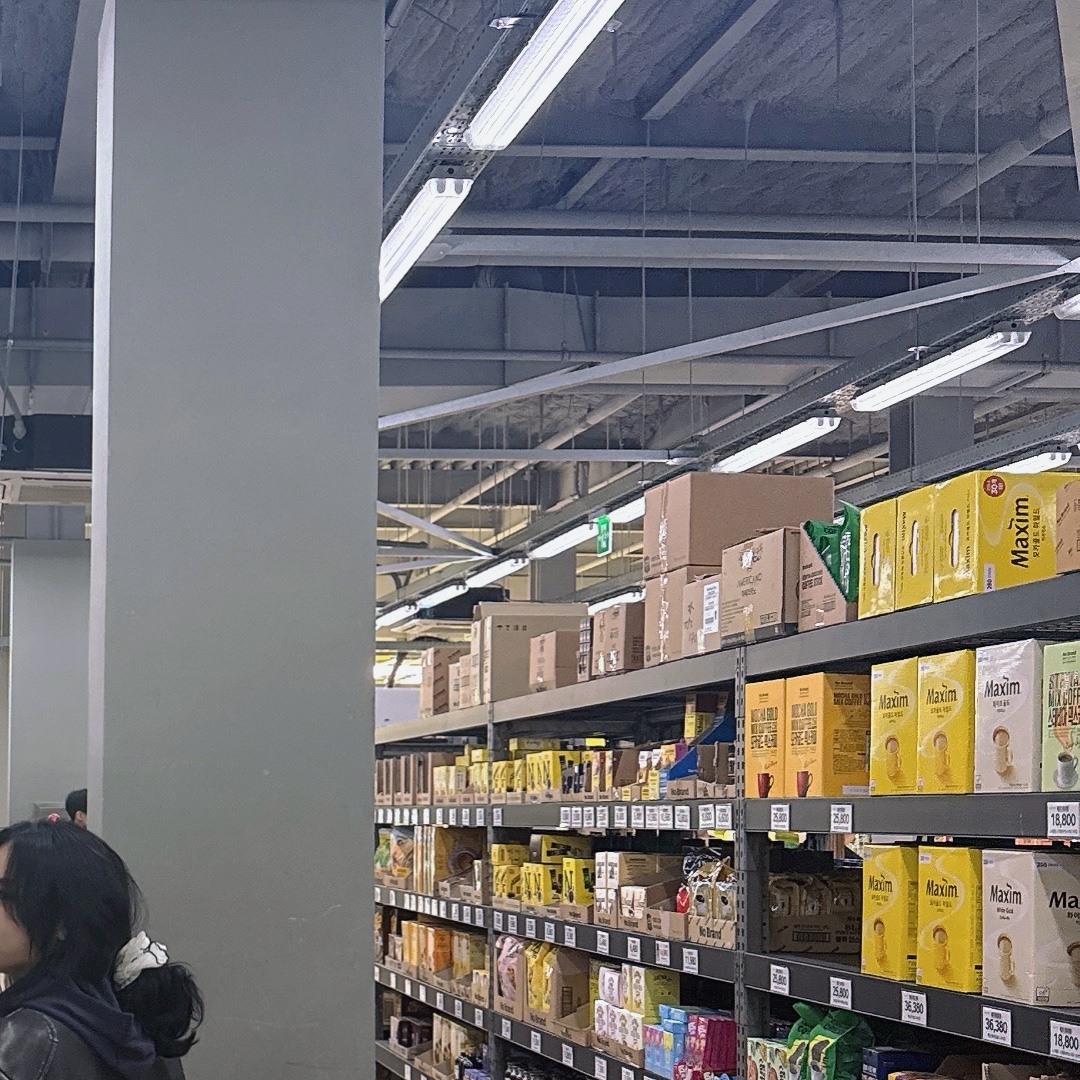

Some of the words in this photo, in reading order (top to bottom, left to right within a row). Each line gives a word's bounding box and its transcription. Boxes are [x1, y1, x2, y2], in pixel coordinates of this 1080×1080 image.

[1007, 496, 1030, 569] Maxim
[925, 684, 957, 706] Maxim
[983, 675, 1021, 699] Maxim
[878, 690, 909, 710] Maxim
[772, 812, 788, 824] 25,800
[832, 812, 850, 825] 25,800
[1050, 812, 1077, 827] 18,800
[868, 874, 893, 894] Maxim
[925, 877, 958, 899] Maxim
[989, 882, 1022, 905] Maxim
[699, 925, 707, 937] No
[706, 926, 722, 940] Brand
[832, 984, 850, 1000] 25,800
[904, 1001, 925, 1016] 36,380
[984, 1019, 1008, 1035] 36,380
[1053, 1032, 1080, 1050] 18,800
